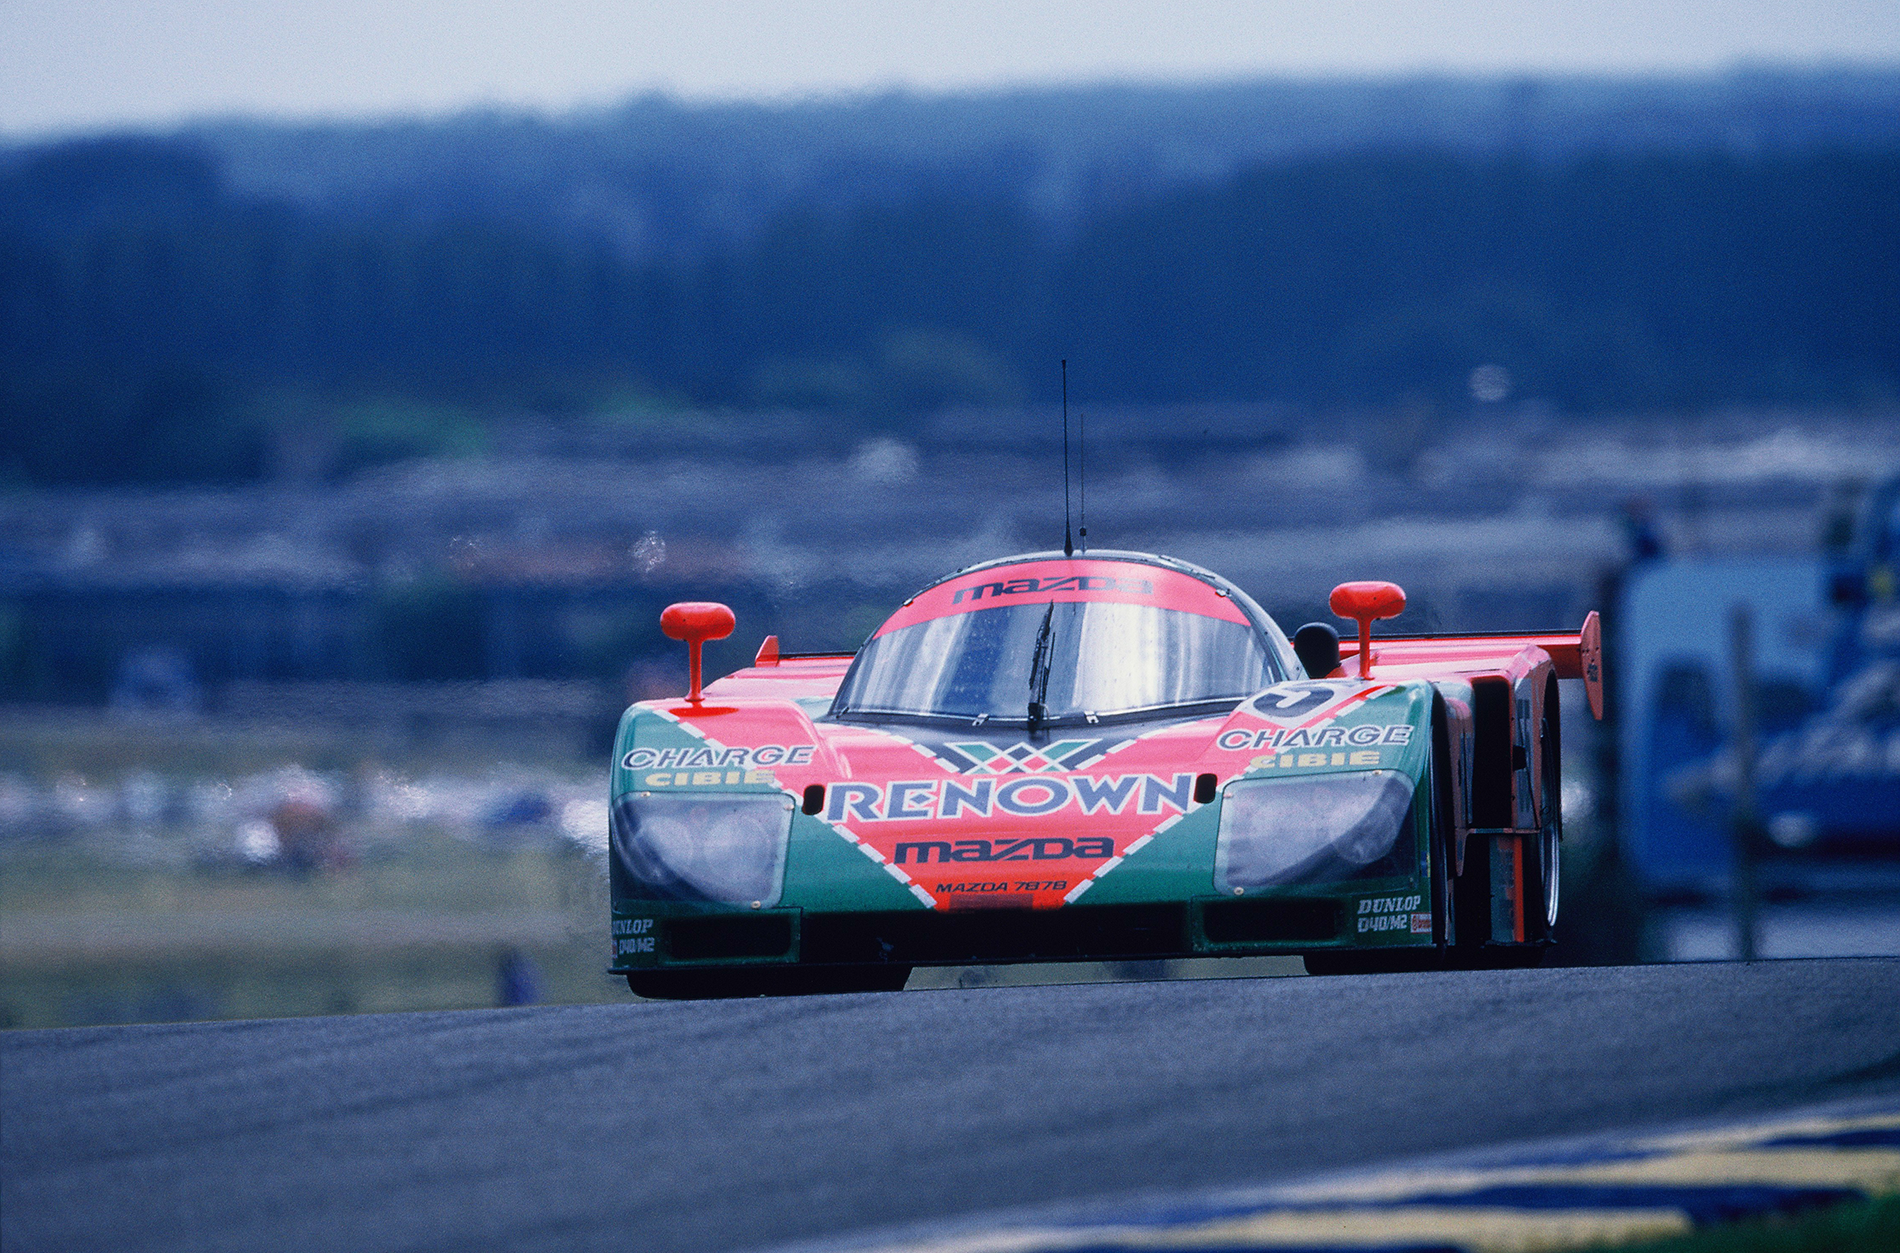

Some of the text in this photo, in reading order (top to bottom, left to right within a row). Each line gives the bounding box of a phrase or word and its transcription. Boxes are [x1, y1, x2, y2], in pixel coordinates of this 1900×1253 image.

[1217, 724, 1414, 752] CHARGE
[622, 744, 818, 770] CHARGE
[1250, 751, 1380, 769] CIBIE
[645, 769, 776, 787] CIBIE
[827, 773, 1197, 823] RENOWN
[894, 837, 1115, 865] mazda
[936, 882, 1008, 893] MAZDA
[1357, 895, 1421, 914] DUNLOP
